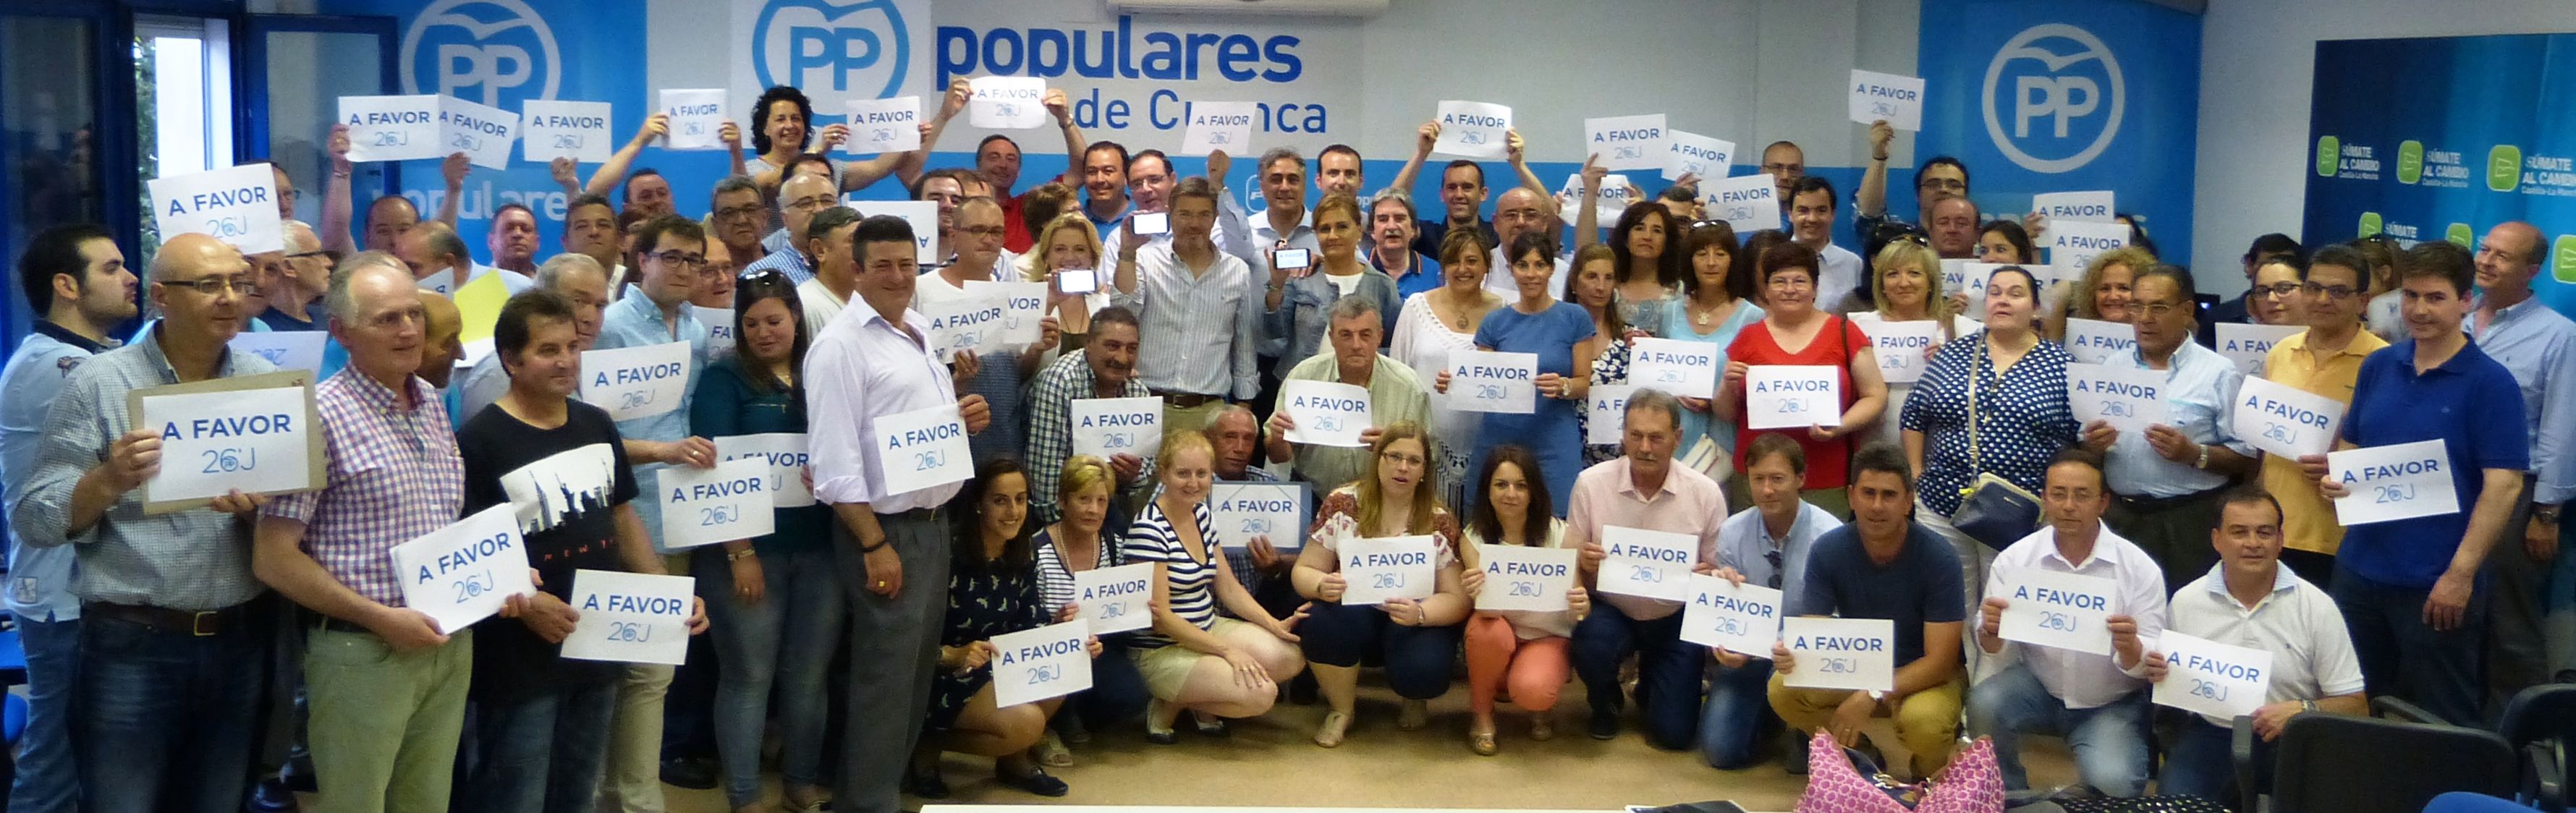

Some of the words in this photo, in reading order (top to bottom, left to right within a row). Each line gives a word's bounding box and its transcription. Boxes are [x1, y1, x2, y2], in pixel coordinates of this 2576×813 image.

[790, 26, 881, 90] PP
[936, 14, 1302, 92] populares
[438, 44, 532, 106] PP
[978, 89, 988, 99] A
[992, 88, 1038, 99] FAVOR
[1856, 83, 1866, 94] A
[1870, 85, 1917, 102] FAVOR
[670, 106, 678, 117] A
[680, 103, 719, 116] FAVOR
[1075, 88, 1130, 130] de
[1149, 88, 1326, 134] Cnca
[2015, 76, 2099, 137] PP
[349, 113, 363, 126] A
[368, 111, 430, 125] FAVOR
[438, 110, 449, 123] A
[452, 113, 507, 137] FAVOR
[533, 115, 544, 127] A
[549, 116, 604, 129] FAVOR
[854, 114, 865, 124] A
[868, 110, 913, 124] FAVOR
[1196, 116, 1206, 126] A
[1209, 115, 1250, 126] FAVOR
[1443, 113, 1454, 124] A
[1458, 114, 1505, 128] FAVOR
[1594, 132, 1605, 142] A
[1609, 128, 1660, 142] FAVOR
[1670, 142, 1679, 153] A
[1682, 145, 1726, 163] FAVOR
[169, 199, 187, 217] A
[193, 186, 267, 212] FAVOR
[1563, 188, 1573, 198] A
[1708, 192, 1718, 204] A
[1722, 187, 1771, 203] FAVOR
[2038, 206, 2049, 217] A
[2054, 205, 2106, 217] FAVOR
[2056, 236, 2067, 247] A
[2072, 237, 2121, 251] FAVOR
[931, 318, 944, 331] A
[949, 307, 1001, 328] FAVOR
[1880, 335, 1930, 349] FAVOR
[2075, 334, 2087, 346] A
[2225, 339, 2239, 352] A
[1638, 351, 1650, 362] A
[1655, 352, 1709, 367] FAVOR
[595, 373, 609, 387] A
[617, 362, 682, 385] FAVOR
[1456, 365, 1468, 378] A
[1474, 366, 1529, 381] FAVOR
[1755, 380, 1768, 393] A
[1773, 380, 1829, 392] FAVOR
[2076, 379, 2089, 392] A
[2095, 380, 2156, 401] FAVOR
[1294, 395, 1305, 408] A
[1311, 396, 1365, 413] FAVOR
[1596, 399, 1609, 411] A
[1081, 415, 1093, 427] A
[1099, 412, 1154, 427] FAVOR
[2245, 395, 2258, 409] A
[2264, 399, 2332, 433] FAVOR
[161, 421, 182, 441] A
[192, 414, 292, 439] FAVOR
[889, 435, 902, 450] A
[905, 422, 961, 446] FAVOR
[2342, 470, 2358, 485] A
[2363, 459, 2440, 481] FAVOR
[671, 488, 687, 503] A
[692, 477, 761, 501] FAVOR
[1220, 500, 1232, 512] A
[1238, 500, 1292, 513] FAVOR
[418, 565, 434, 585] A
[438, 532, 512, 575] FAVOR
[1350, 555, 1363, 568] A
[1368, 552, 1426, 567] FAVOR
[1609, 542, 1622, 556] A
[1628, 545, 1687, 564] FAVOR
[1487, 561, 1501, 574] A
[1507, 562, 1567, 576] FAVOR
[1082, 587, 1093, 601] A
[1098, 579, 1146, 598] FAVOR
[2014, 585, 2029, 600] A
[2036, 587, 2106, 611] FAVOR
[582, 593, 600, 611] A
[608, 595, 682, 616] FAVOR
[1695, 592, 1708, 606] A
[1714, 595, 1773, 619] FAVOR
[1001, 651, 1015, 666] A
[1020, 638, 1081, 662] FAVOR
[1794, 636, 1808, 650] A
[1816, 636, 1883, 652] FAVOR
[2166, 650, 2182, 667] A
[2188, 655, 2260, 683] FAVOR
